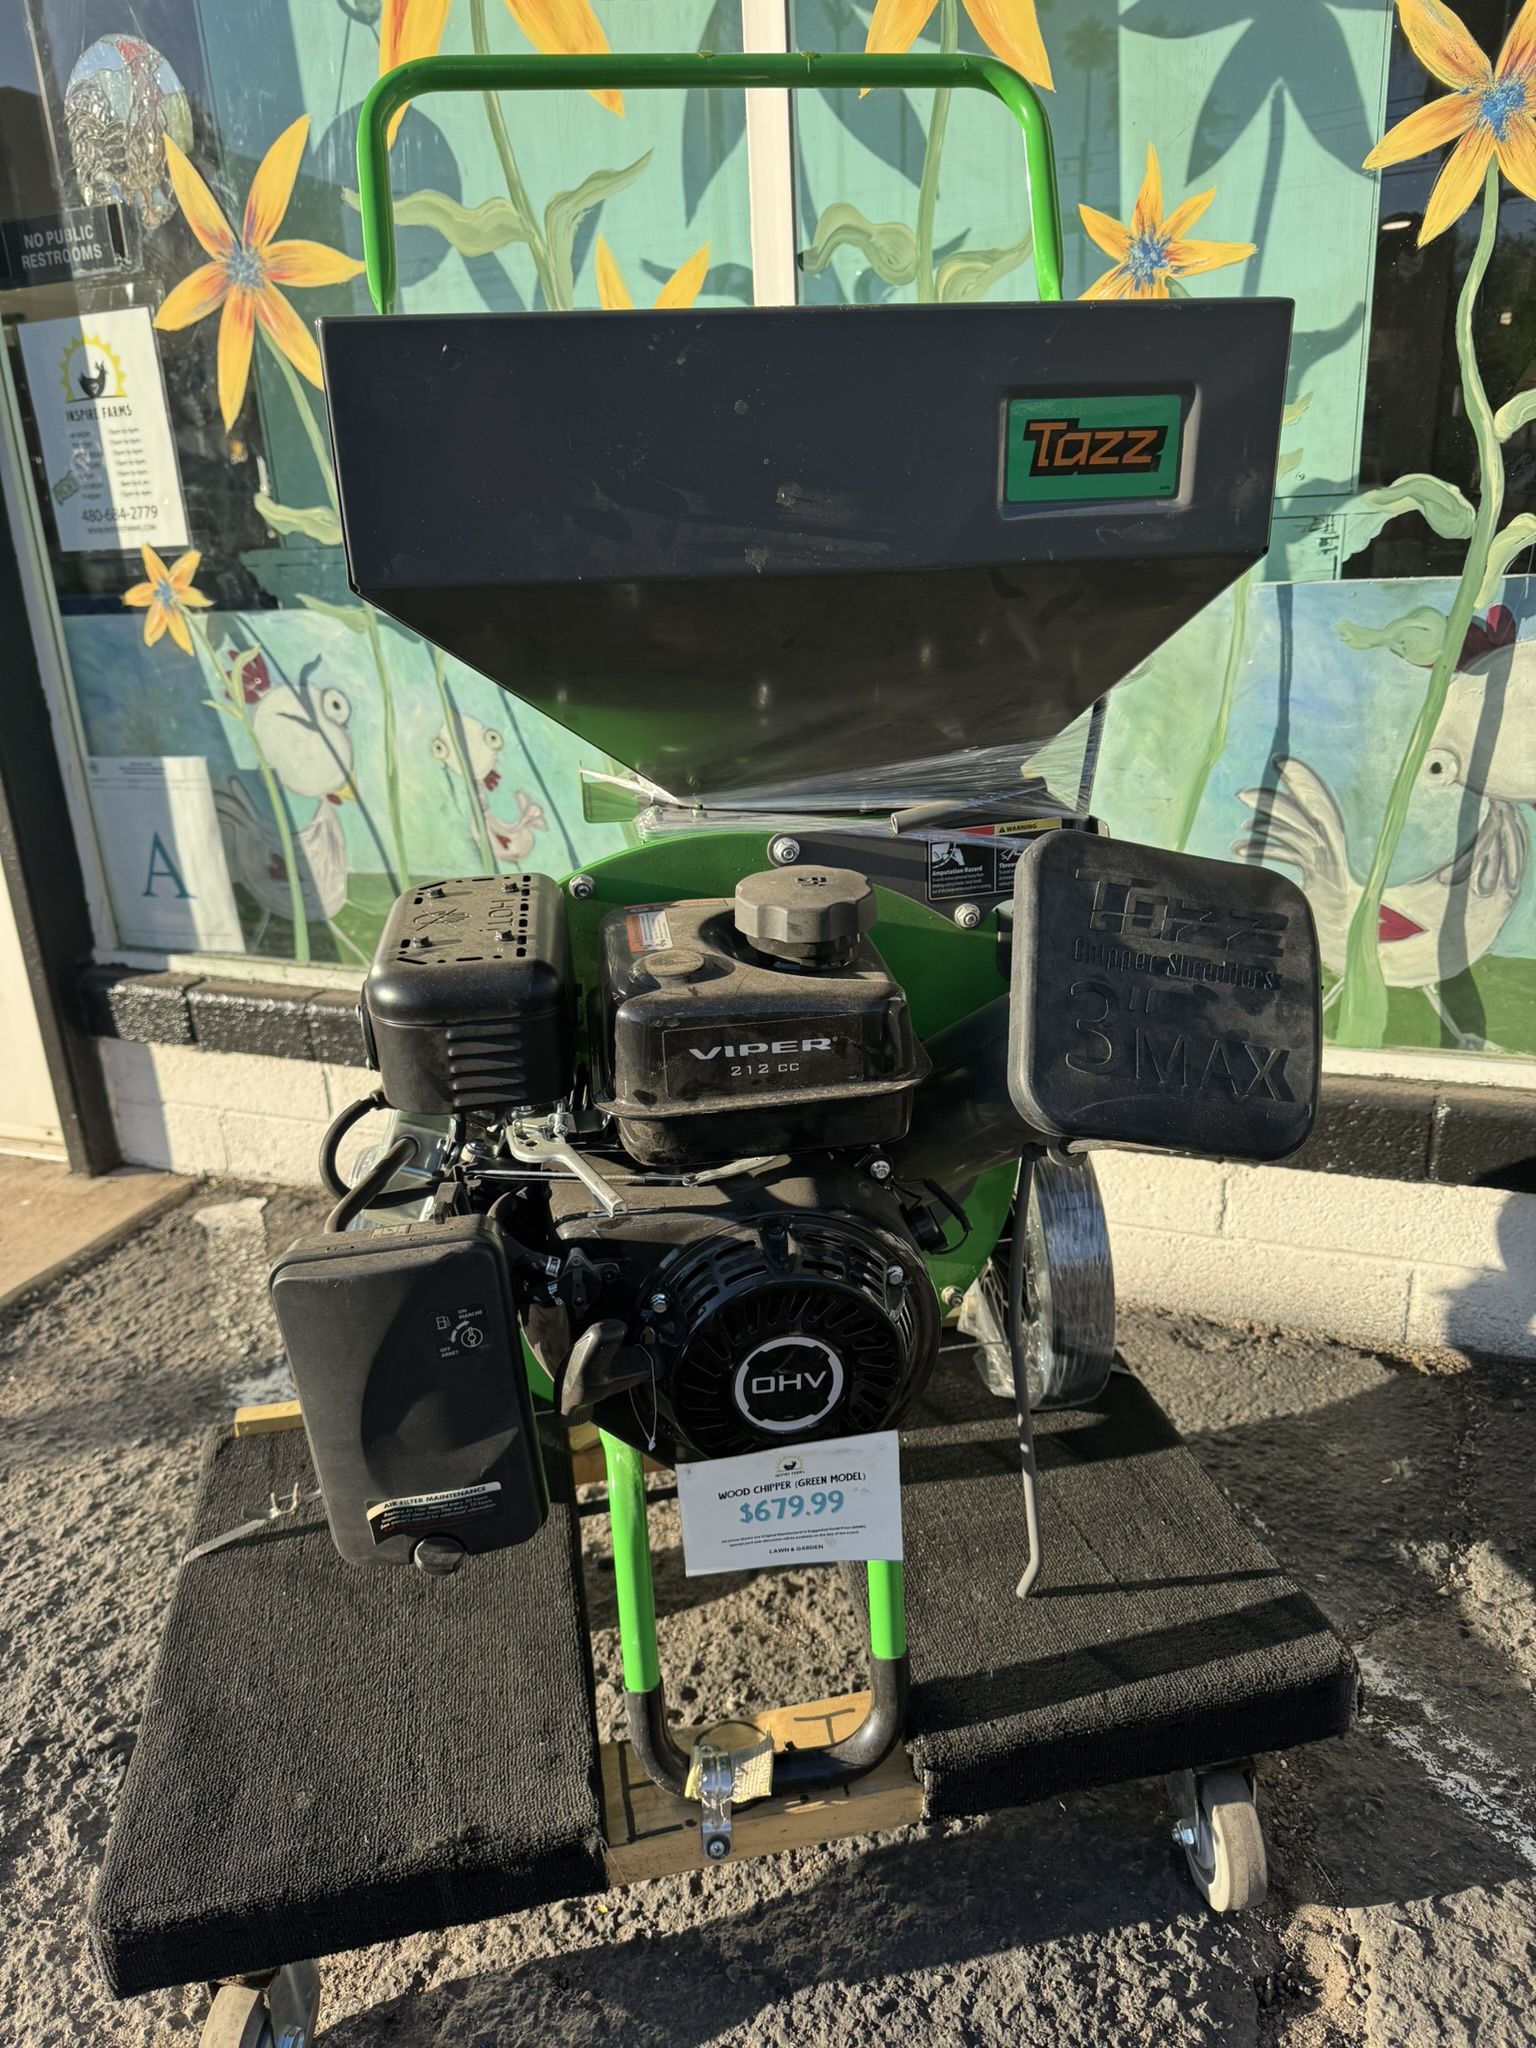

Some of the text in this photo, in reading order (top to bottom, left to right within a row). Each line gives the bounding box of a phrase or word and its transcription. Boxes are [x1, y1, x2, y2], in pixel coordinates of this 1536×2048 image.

[23, 224, 95, 249] NO PUBLIC
[21, 244, 103, 269] RESTROOMS
[65, 404, 132, 421] INSPIRE FARMS
[1027, 420, 1160, 469] Tazz
[1006, 823, 1038, 832] WARNING
[142, 831, 198, 899] A
[932, 865, 983, 876] Amputation Hazard
[1074, 937, 1282, 990] Chipper Shredders
[689, 1038, 832, 1060] VIPER
[730, 1064, 769, 1077] 212
[1134, 1027, 1297, 1102] MAX
[752, 1371, 827, 1394] OHV
[399, 1498, 424, 1506] FILTER
[426, 1486, 487, 1502] MAINTENANCE
[718, 1472, 866, 1501] WOOD CHIPPER (GREEN MODEL)
[740, 1490, 844, 1524] $679.99
